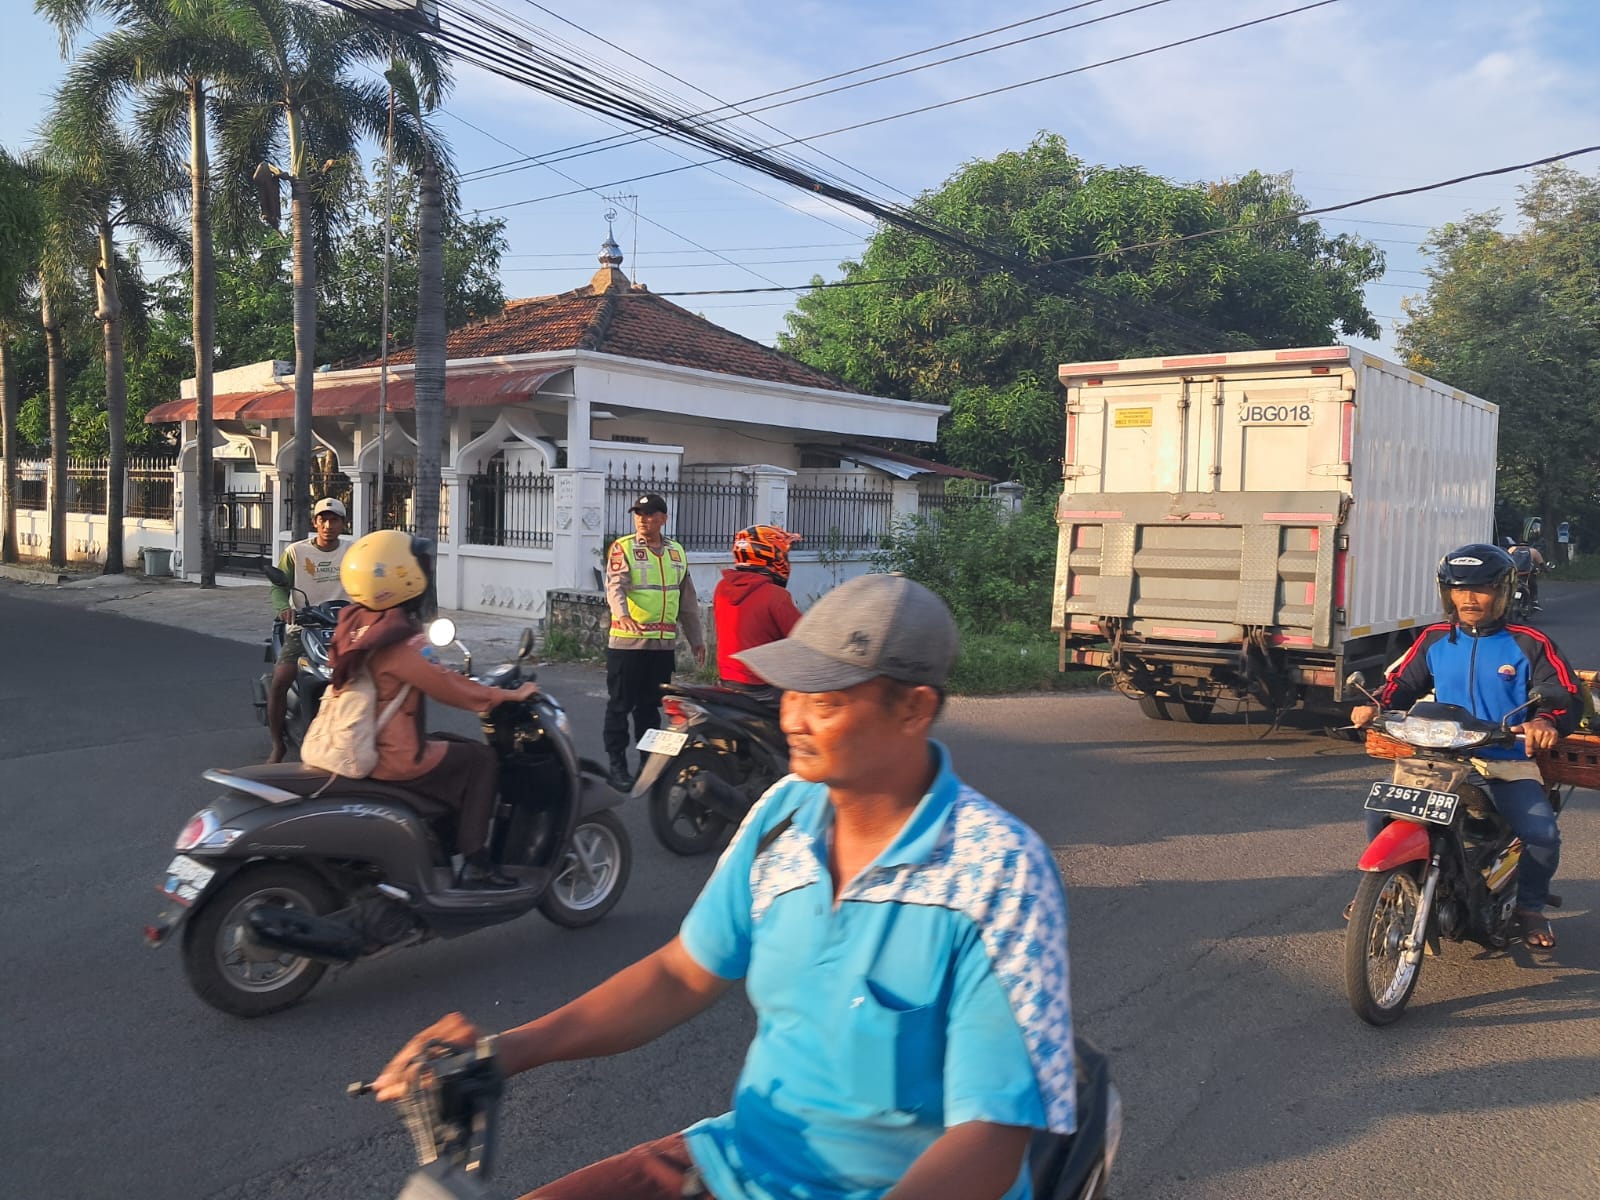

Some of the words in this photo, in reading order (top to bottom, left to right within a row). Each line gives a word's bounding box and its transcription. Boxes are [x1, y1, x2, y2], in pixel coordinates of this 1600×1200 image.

[1240, 405, 1310, 421] JBG018
[1373, 785, 1382, 796] S
[1386, 787, 1421, 802] 2967
